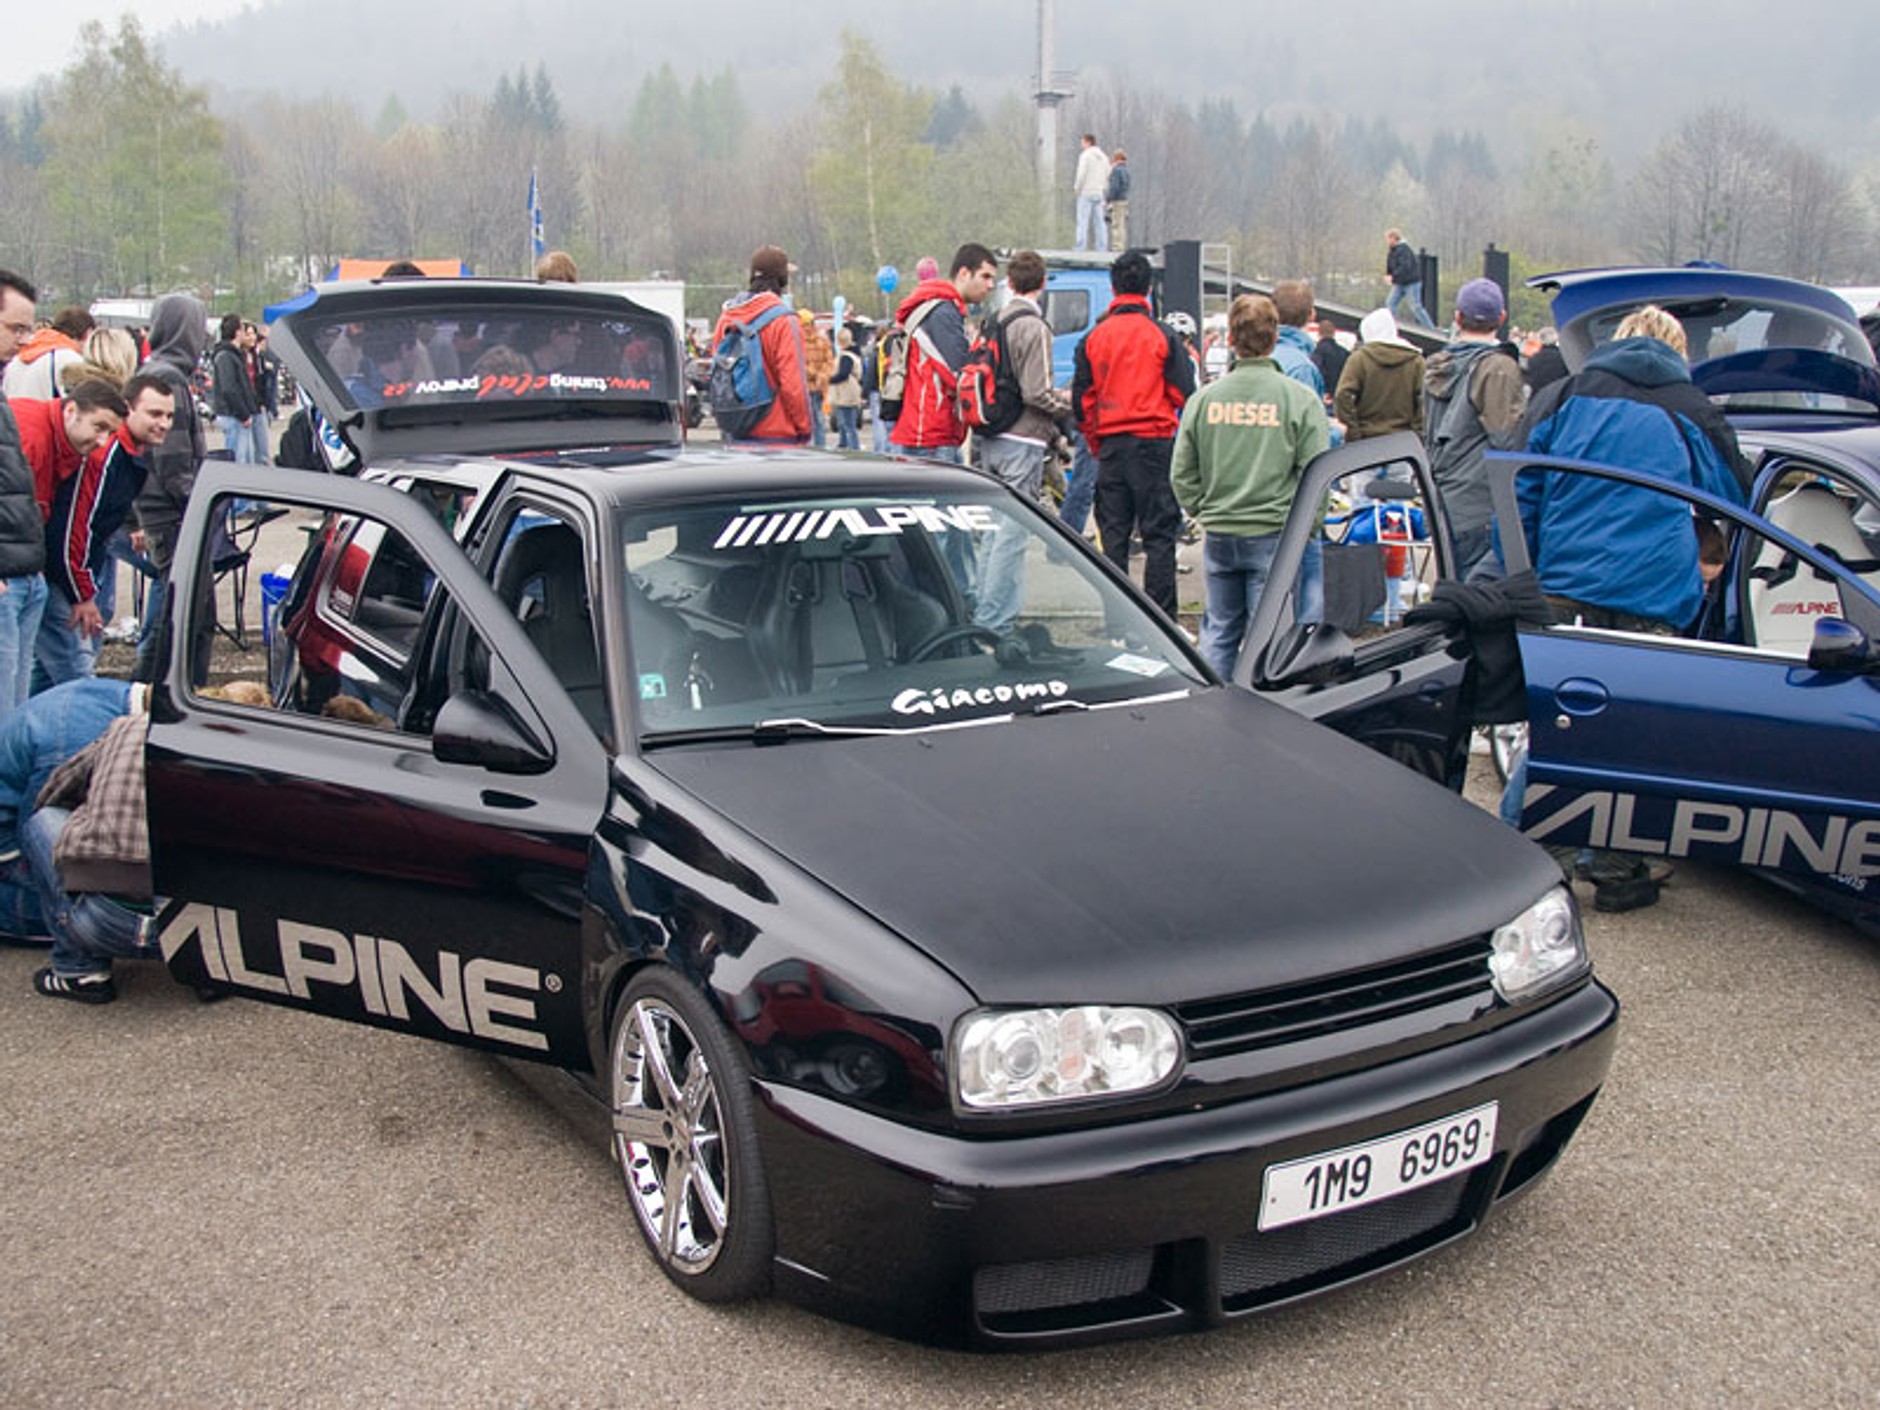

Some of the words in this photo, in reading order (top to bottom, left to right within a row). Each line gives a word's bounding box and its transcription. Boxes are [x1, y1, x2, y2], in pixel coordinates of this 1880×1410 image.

[1207, 402, 1280, 426] DIESEL
[891, 680, 1068, 715] Giacomo
[1305, 1154, 1372, 1210] 1M9
[1400, 1118, 1481, 1183] 6969
